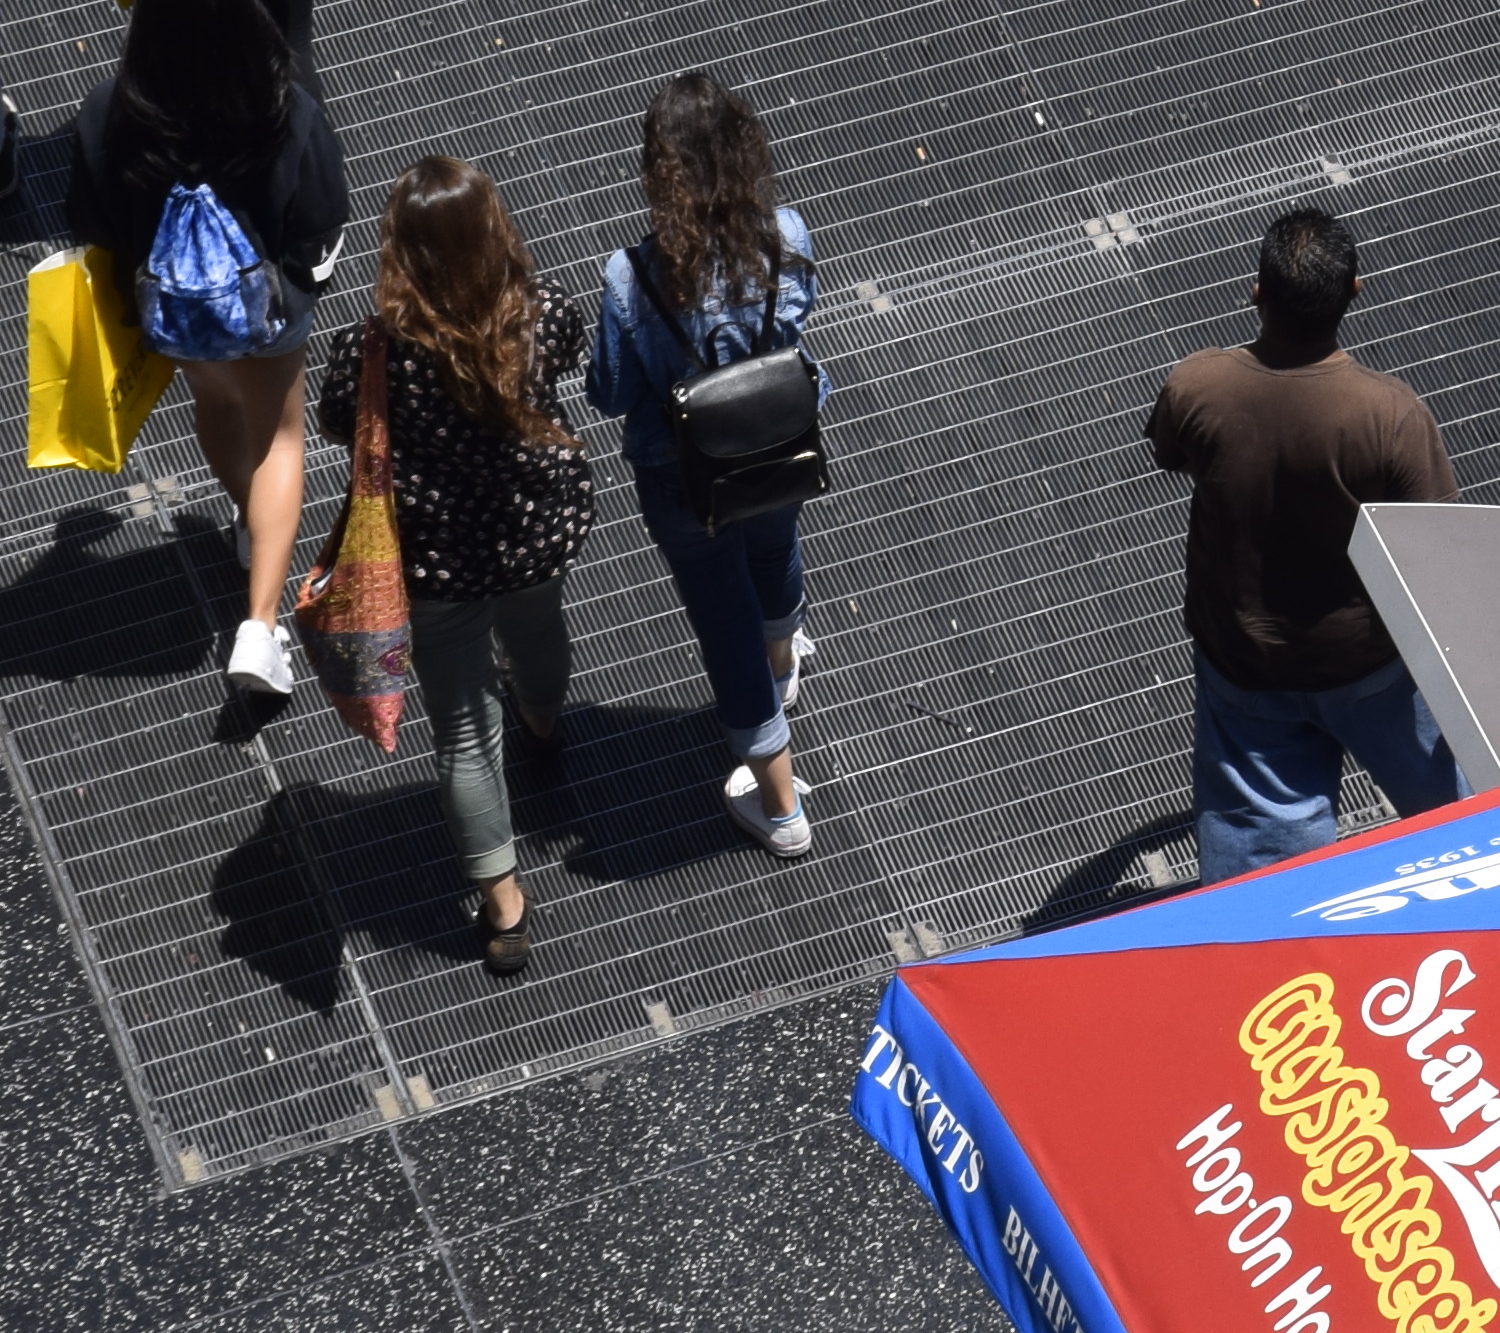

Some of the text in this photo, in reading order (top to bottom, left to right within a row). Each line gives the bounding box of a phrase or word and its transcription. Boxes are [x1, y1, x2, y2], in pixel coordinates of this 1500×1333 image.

[1395, 844, 1481, 876] 1935
[861, 1025, 984, 1194] TICKETS
[1176, 1103, 1293, 1288] Hop-On
